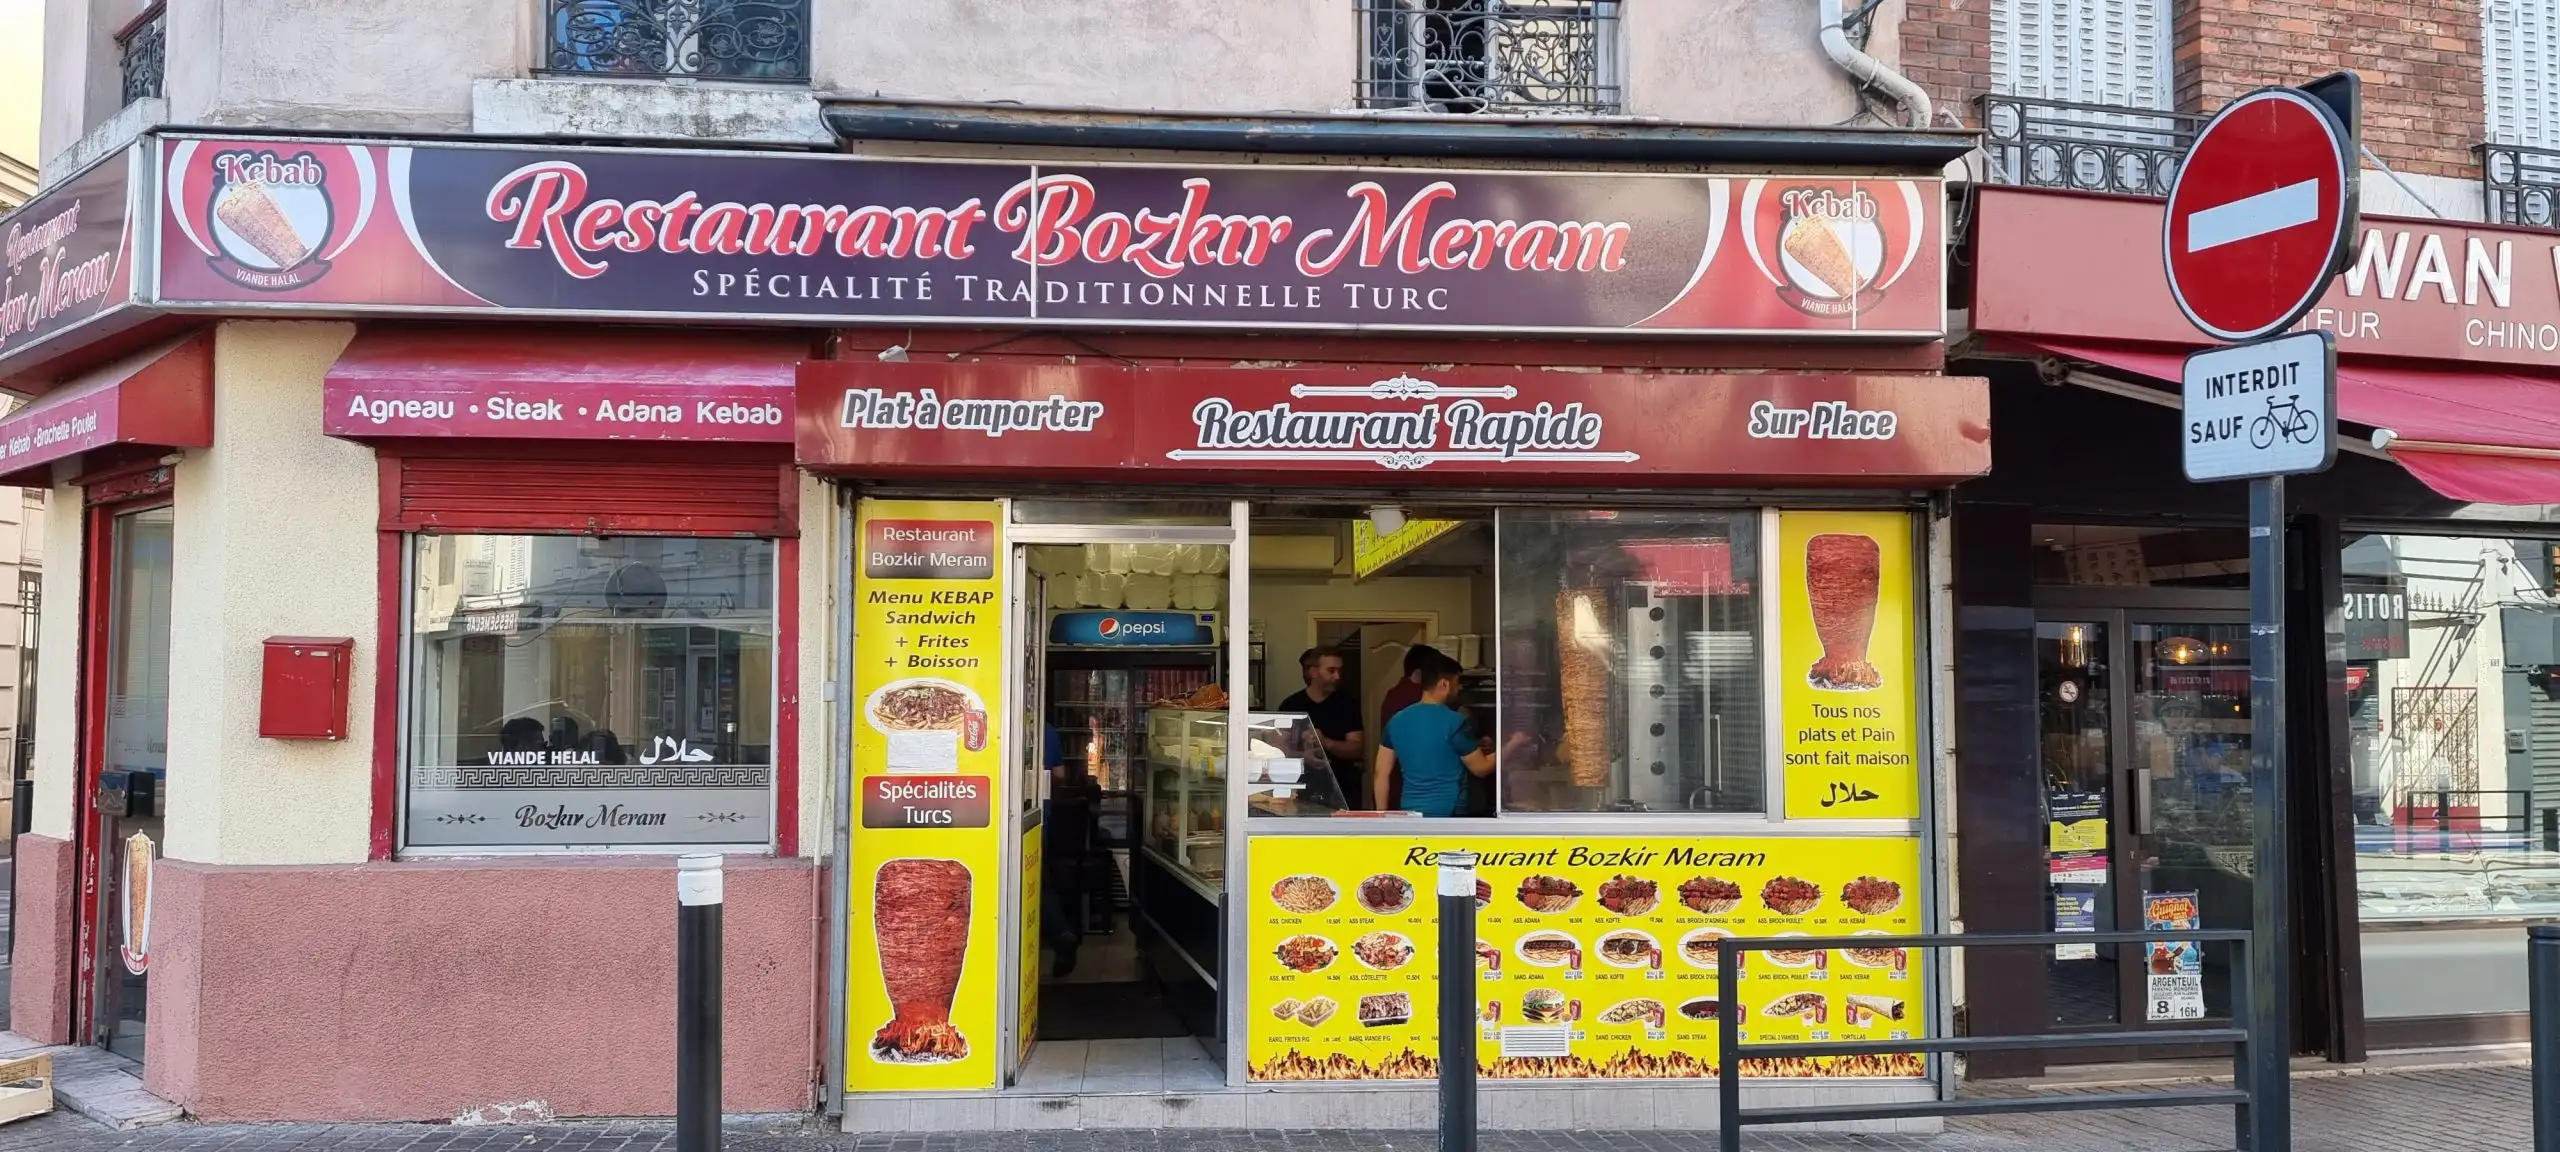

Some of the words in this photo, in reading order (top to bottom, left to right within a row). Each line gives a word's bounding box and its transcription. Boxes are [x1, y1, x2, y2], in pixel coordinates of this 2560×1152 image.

[216, 153, 322, 186] Kebab
[1783, 189, 1877, 220] Kebab
[486, 161, 986, 280] Restaurant
[1295, 180, 1632, 278] Meram
[6, 199, 81, 276] Restaurant
[236, 268, 269, 286] VIANDE
[271, 273, 301, 286] HALAL
[2343, 228, 2513, 307] WAN
[28, 247, 111, 332] Meram
[693, 267, 933, 300] SPÉCIALITÉ
[956, 275, 1322, 309] TRADITIONNELLE
[1343, 283, 1450, 311] TURC
[1801, 298, 1831, 314] VIANDE
[2465, 318, 2559, 352] CHINO
[2205, 361, 2300, 400] INTERDIT
[348, 395, 454, 425] Agneau
[486, 397, 564, 422] Steak
[595, 399, 682, 423] Adana
[696, 401, 783, 425] Kebab
[842, 388, 913, 428] Plat
[916, 390, 941, 426] à
[944, 394, 1102, 435] emporter
[1749, 400, 1808, 437] Sur
[1810, 402, 1896, 439] Place
[9, 433, 31, 457] Kebab
[36, 420, 70, 448] Brochette
[71, 409, 97, 437] Poulet
[1195, 399, 1437, 448] Restaurant
[1448, 399, 1602, 459] Rapide
[2190, 416, 2244, 444] SAUF
[883, 526, 976, 542] Restaurant
[872, 552, 923, 567] Bozkir
[930, 552, 987, 567] Meram
[868, 590, 923, 604] Menu
[930, 591, 994, 604] KEBAP
[885, 610, 976, 625] Sandwich
[1122, 620, 1165, 636] pepsi
[918, 634, 969, 648] Frites
[907, 654, 979, 668] Boisson
[1811, 704, 1848, 718] Tous
[1853, 707, 1881, 718] nos
[1798, 727, 1836, 745] plats
[1841, 728, 1857, 742] et
[1862, 727, 1895, 742] Pain
[487, 750, 546, 766] VIANDE
[551, 750, 600, 766] HELAL
[639, 735, 714, 766] حلال
[1786, 752, 1819, 766] sont
[1825, 750, 1851, 766] fait
[1856, 751, 1910, 766] maison
[879, 780, 977, 803] Spécialités
[1820, 781, 1880, 807] حلال
[585, 804, 667, 829] Meram
[903, 806, 953, 824] Turcs
[1404, 846, 1556, 867] Reurant
[1567, 846, 1657, 867] Bozkir
[1663, 847, 1766, 867] Meram
[2152, 976, 2198, 987] ARGENTEUIL
[2157, 1001, 2170, 1013] 8
[2180, 1006, 2198, 1017] 16H
